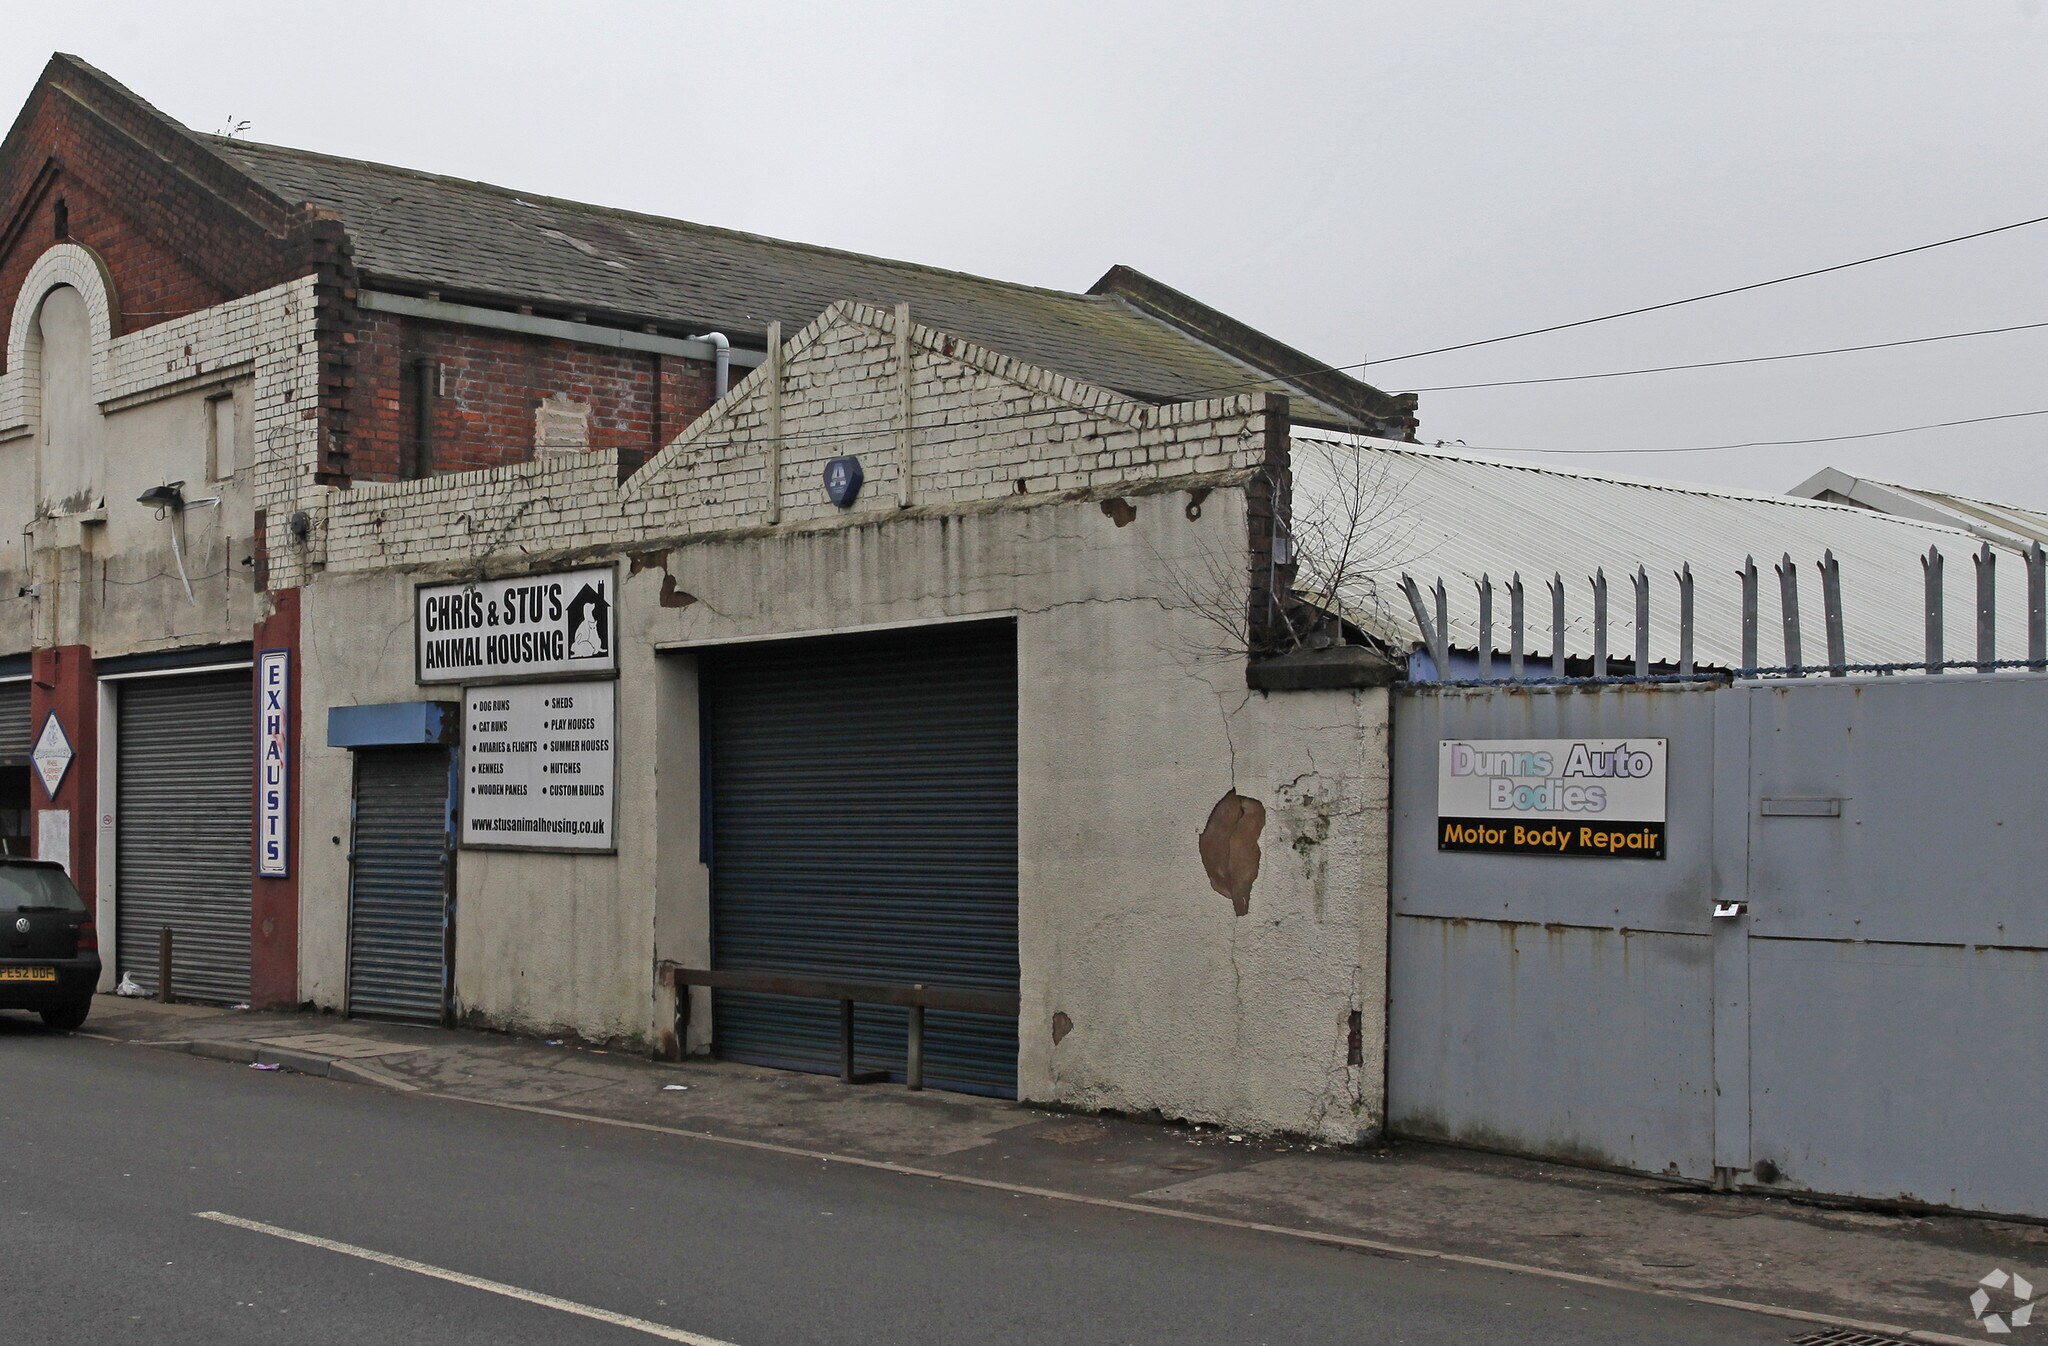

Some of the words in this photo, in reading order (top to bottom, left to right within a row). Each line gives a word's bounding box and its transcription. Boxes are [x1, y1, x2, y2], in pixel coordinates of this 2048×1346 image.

[425, 592, 483, 632] CHRIS
[487, 600, 499, 626] &
[503, 583, 562, 625] STU'S
[425, 637, 483, 669] ANIMAL
[486, 629, 564, 665] HOUSING
[479, 701, 491, 711] DOG
[493, 700, 510, 711] RUNS
[551, 697, 573, 709] SHEDS
[479, 722, 490, 732] CAT
[491, 721, 508, 732] RUNS
[551, 719, 566, 730] PLAY
[568, 718, 595, 730] HOUSES
[479, 742, 505, 753] AVIARIES
[506, 743, 511, 752] &
[512, 741, 537, 752] FLIGHTS
[550, 741, 580, 752] SUMMER
[581, 740, 609, 751] HOUSES
[266, 665, 281, 861] EXHAUSTS
[1451, 744, 1553, 777] Dunns
[1563, 743, 1653, 778] Auto
[478, 763, 504, 774] KENNELS
[550, 763, 581, 774] HUTCHES
[478, 785, 504, 795] WOODEN
[505, 785, 528, 795] PANELS
[549, 785, 578, 796] CUSTOM
[579, 785, 605, 796] BUILDS
[1489, 778, 1607, 812] Bodies
[471, 817, 605, 835] www.stusanimalhousing.co.uk
[1444, 824, 1508, 844] Motor
[1513, 826, 1572, 850] Body
[1579, 827, 1659, 852] Repair
